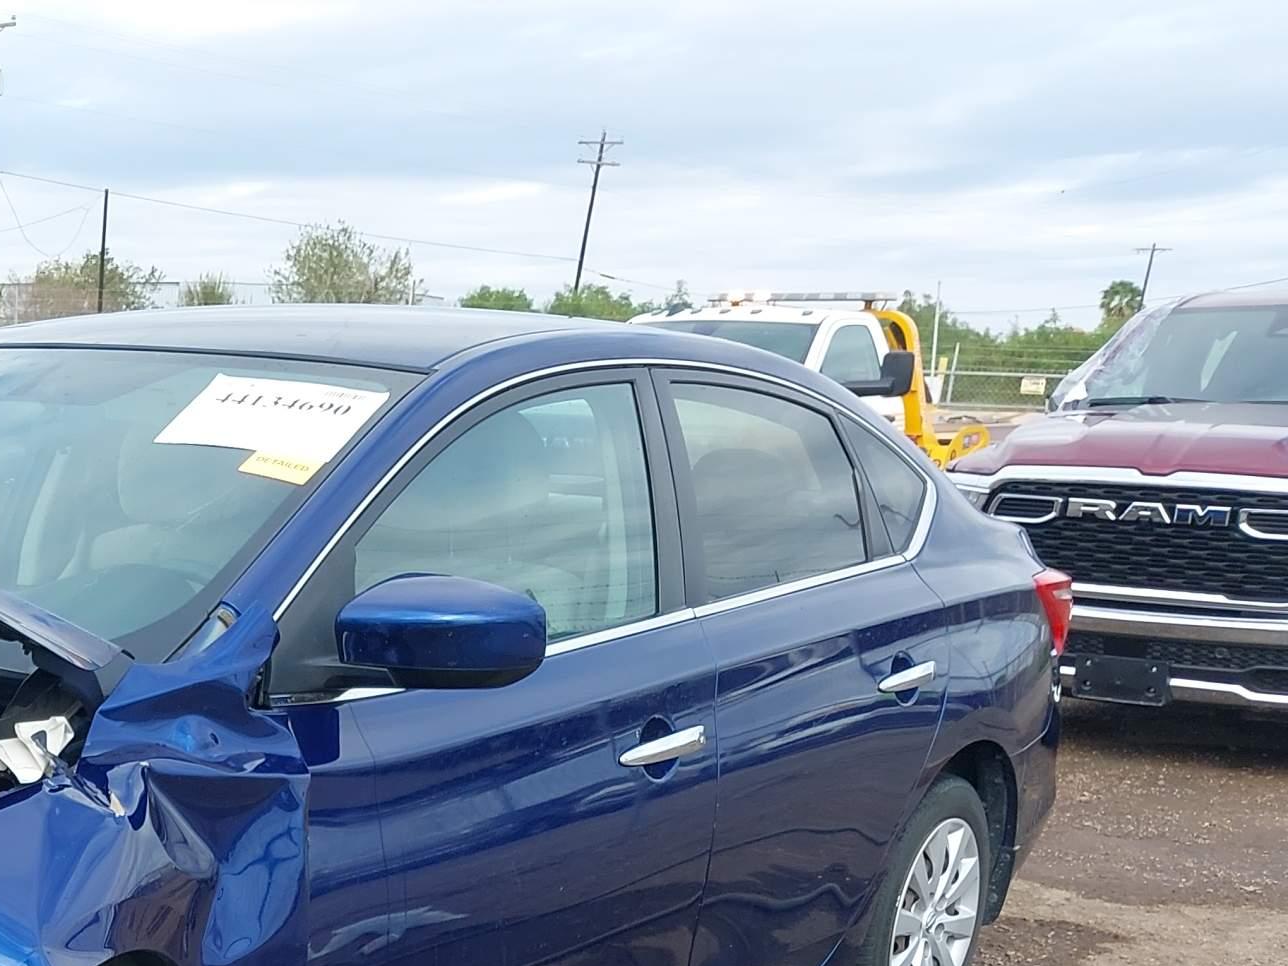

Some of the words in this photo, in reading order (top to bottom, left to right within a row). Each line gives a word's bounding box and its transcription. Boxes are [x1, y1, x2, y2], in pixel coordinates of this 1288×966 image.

[216, 392, 352, 415] 44134690
[256, 456, 310, 472] DETAILED
[1066, 497, 1231, 527] RAM
